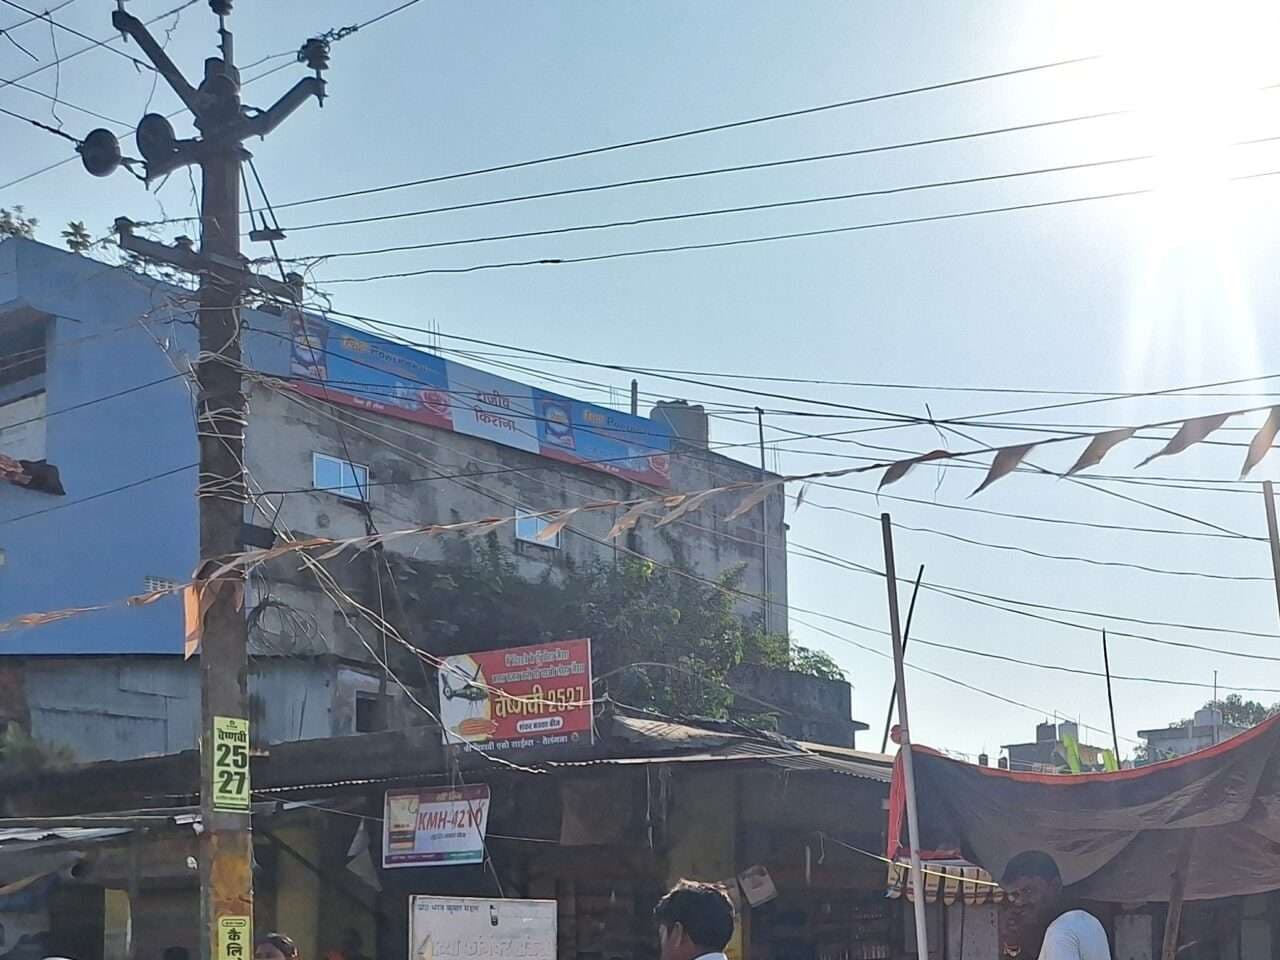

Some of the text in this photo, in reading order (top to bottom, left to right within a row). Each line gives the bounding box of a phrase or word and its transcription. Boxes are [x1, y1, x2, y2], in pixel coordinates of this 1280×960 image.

[548, 686, 585, 712] 2527
[216, 727, 247, 743] वैष्णवी
[216, 743, 248, 769] 25
[218, 770, 246, 795] 27
